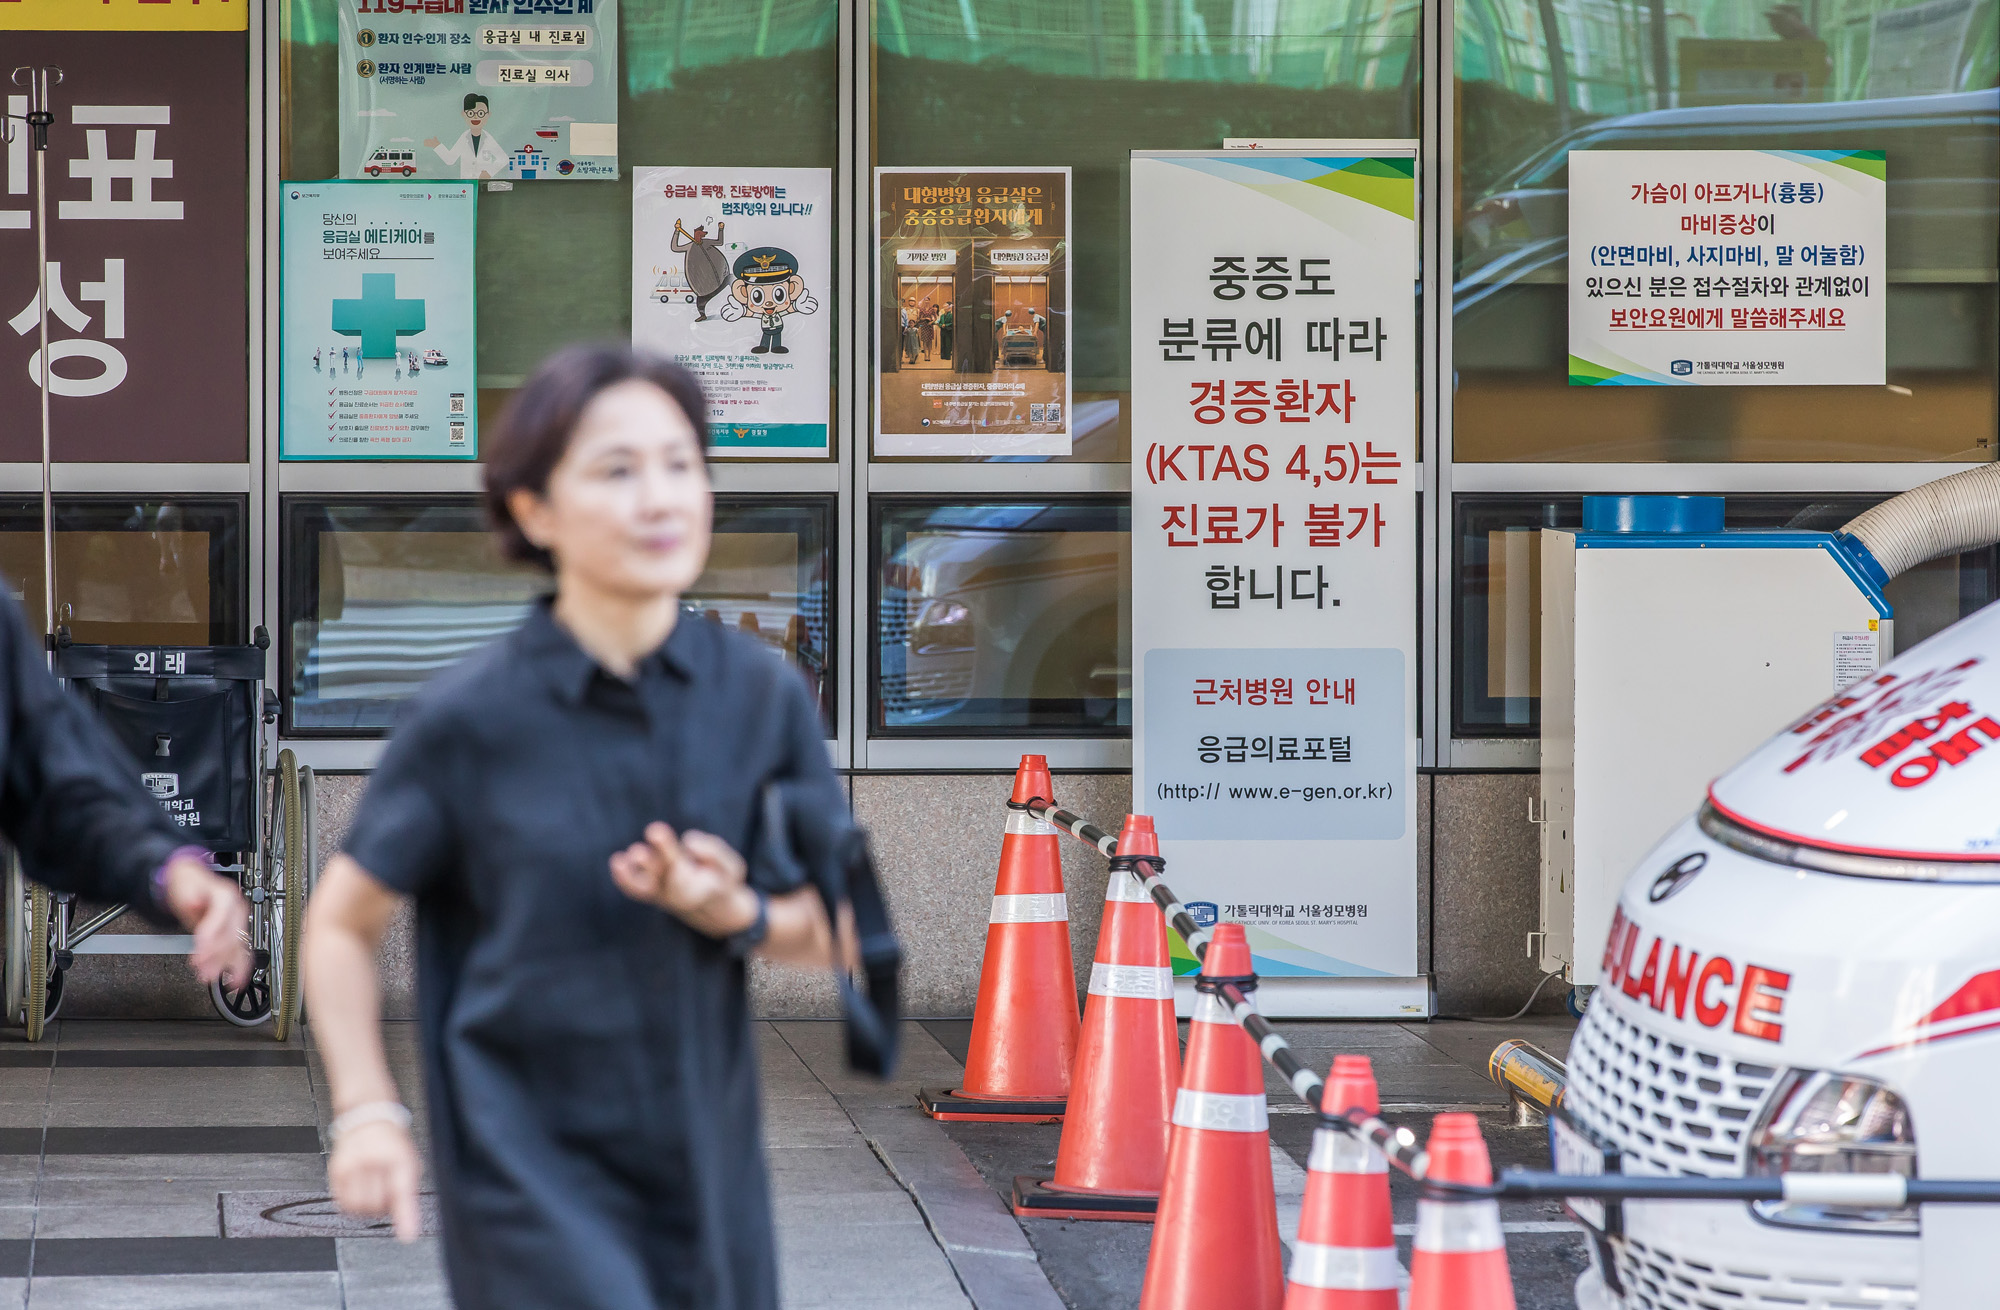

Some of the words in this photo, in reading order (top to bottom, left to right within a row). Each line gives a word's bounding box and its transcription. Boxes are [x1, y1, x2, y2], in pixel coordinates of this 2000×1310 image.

[378, 32, 400, 45] 환자
[450, 33, 471, 45] 장소
[484, 30, 521, 45] 응급실
[529, 30, 541, 43] 내
[548, 30, 585, 45] 진료실
[378, 62, 400, 75] 환자
[403, 62, 447, 75] 인계받는
[450, 62, 472, 75] 사람
[500, 68, 537, 82] 진료실
[545, 68, 569, 82] 의사
[379, 76, 408, 85] (서명하는
[410, 75, 426, 85] 사람)
[576, 166, 614, 175] 소방재난본부
[664, 184, 698, 198] 응급실
[701, 184, 727, 199] 폭행,
[730, 184, 787, 199] 진료방해는
[904, 186, 971, 204] 대형병원
[975, 186, 1043, 204] 응급실은
[1630, 182, 1687, 204] 가슴이
[1694, 182, 1825, 204] 아프거나(흉통)
[722, 202, 767, 216] 범죄행위
[770, 202, 813, 216] 입니다!!
[904, 208, 1043, 226] 중증응급환자에게
[322, 214, 357, 226] 당신의
[1680, 214, 1775, 235] 마비증상이
[322, 230, 361, 244] 응급실
[323, 248, 381, 261] 보여주세요
[906, 252, 929, 261] 가까운
[931, 252, 947, 261] 병원
[1025, 252, 1049, 261] 응급실
[1590, 245, 1680, 268] (안면마비,
[1686, 245, 1769, 268] 사지마비,
[1776, 245, 1795, 266] 말
[1800, 245, 1865, 267] 어눌함)
[1209, 256, 1335, 300] 중증도
[1586, 276, 1642, 298] 있으신
[1648, 276, 1687, 298] 분은
[1693, 276, 1789, 298] 접수절차와
[1795, 276, 1870, 298] 관계없이
[1609, 307, 1724, 329] 보안요원에게
[1730, 307, 1846, 329] 말씀해주세요
[1158, 317, 1282, 362] 분류에
[1306, 317, 1388, 362] 따라
[1696, 361, 1740, 370] 가톨릭대학교
[1742, 361, 1785, 370] 서울성모병원
[1190, 379, 1356, 425] 경증환자
[1146, 442, 1270, 485] (KTAS
[1286, 442, 1402, 488] 4,5)는
[1161, 503, 1285, 548] 진료가
[1304, 503, 1386, 548] 불가
[1205, 565, 1341, 610] 합니다.
[134, 652, 186, 675] 외래
[1193, 678, 1294, 706] 근처병원
[1306, 678, 1356, 706] 안내
[1198, 735, 1352, 764] 응급의료포털
[1157, 782, 1220, 802] (http://
[1229, 782, 1393, 802] www.e-gen.or.kr)
[169, 812, 201, 827] 병원
[1224, 904, 1295, 918] 가톨릭대학교
[1298, 904, 1368, 918] 서울성모병원
